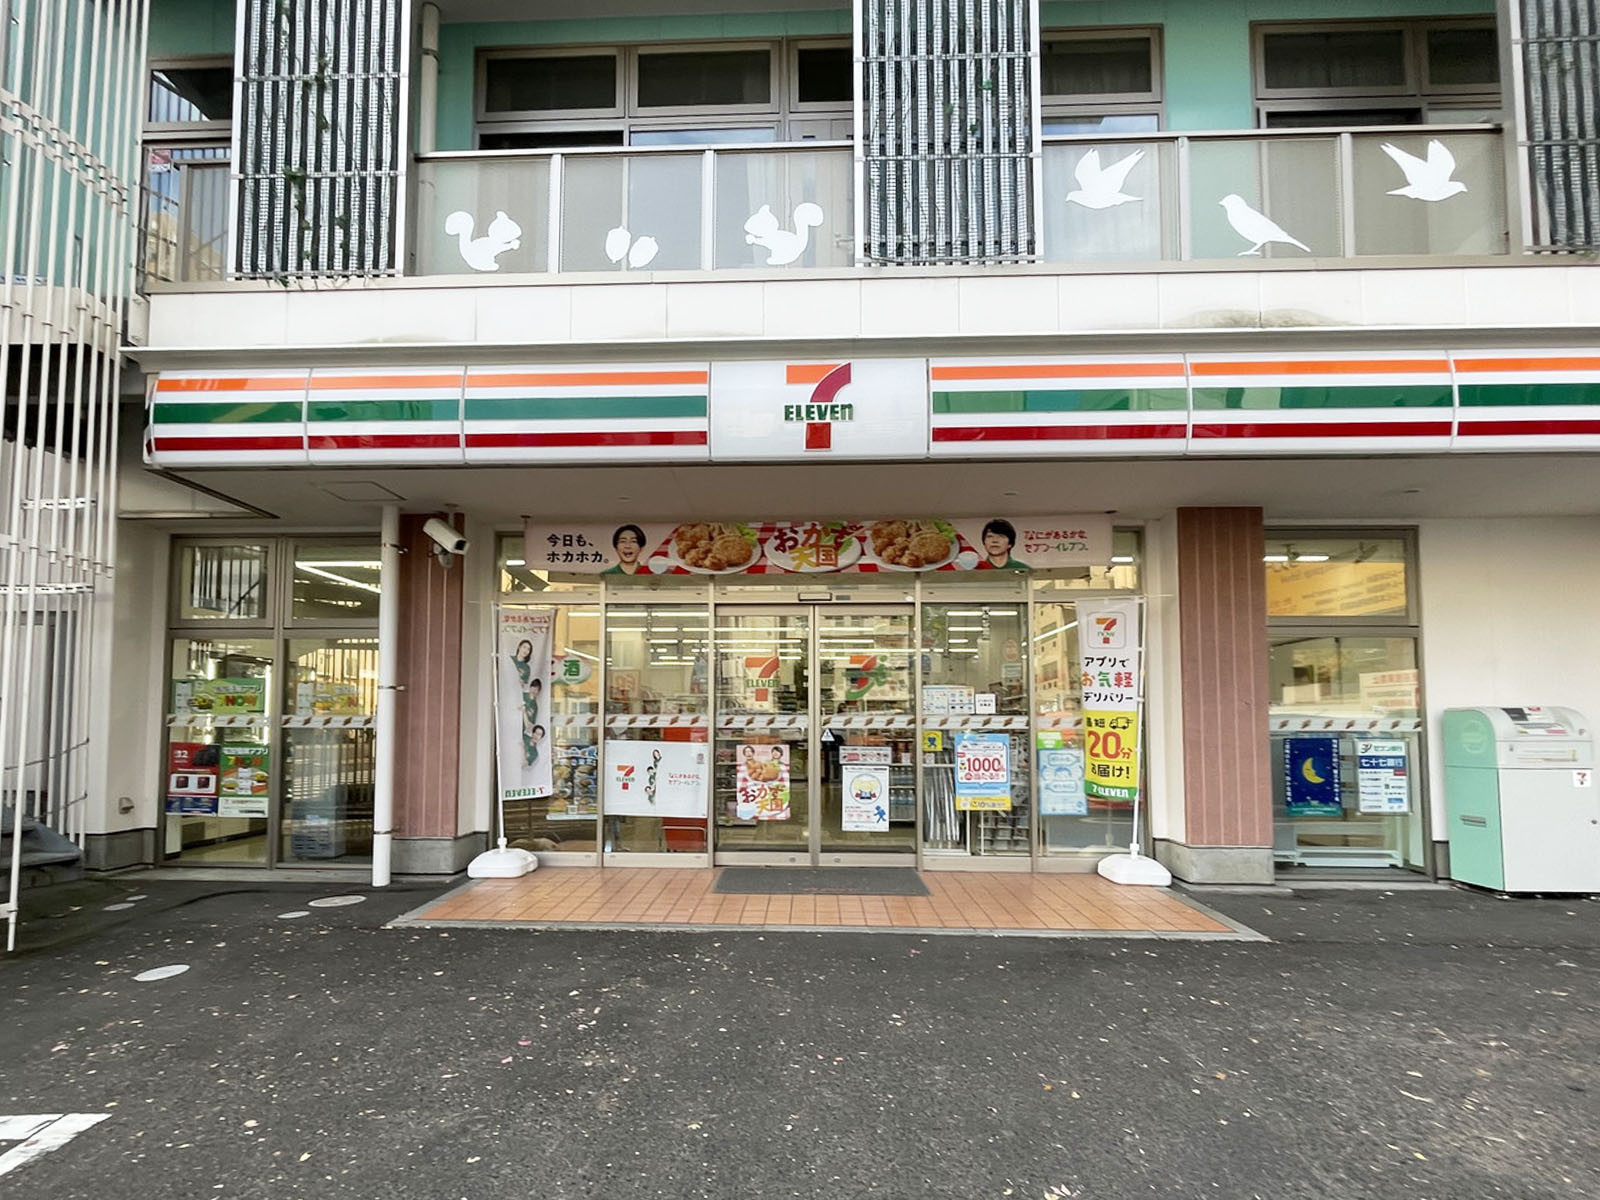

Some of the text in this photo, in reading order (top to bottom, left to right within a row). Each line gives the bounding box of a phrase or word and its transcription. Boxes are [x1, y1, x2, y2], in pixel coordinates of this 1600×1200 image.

[786, 362, 852, 450] 7
[547, 533, 594, 547] 今日も、
[547, 551, 609, 564] ホカホカ。
[563, 659, 580, 677] 酒
[1081, 671, 1134, 688] お気軽
[1083, 692, 1133, 703] デリバリー
